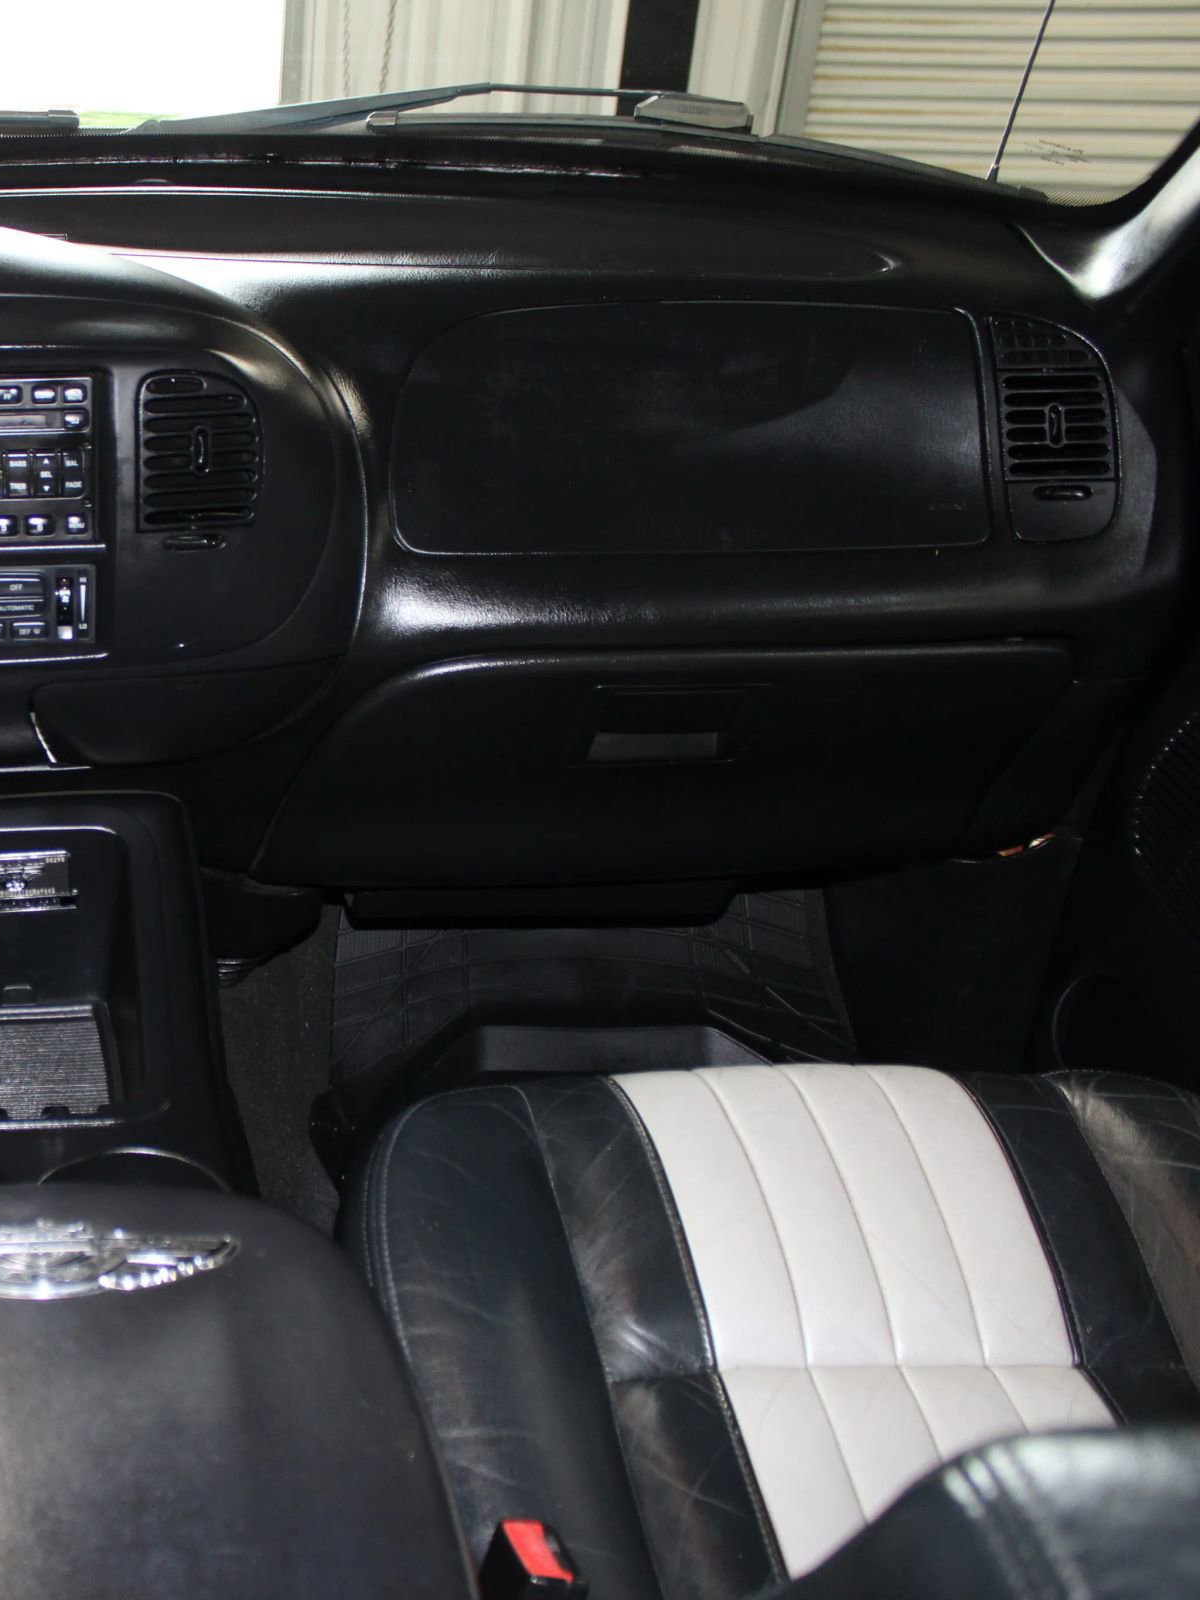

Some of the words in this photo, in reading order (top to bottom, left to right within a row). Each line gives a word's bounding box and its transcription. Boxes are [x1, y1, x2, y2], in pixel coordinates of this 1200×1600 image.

[65, 459, 79, 467] BAL
[40, 470, 52, 478] SEL
[9, 482, 27, 490] TREB
[65, 480, 83, 489] FADE
